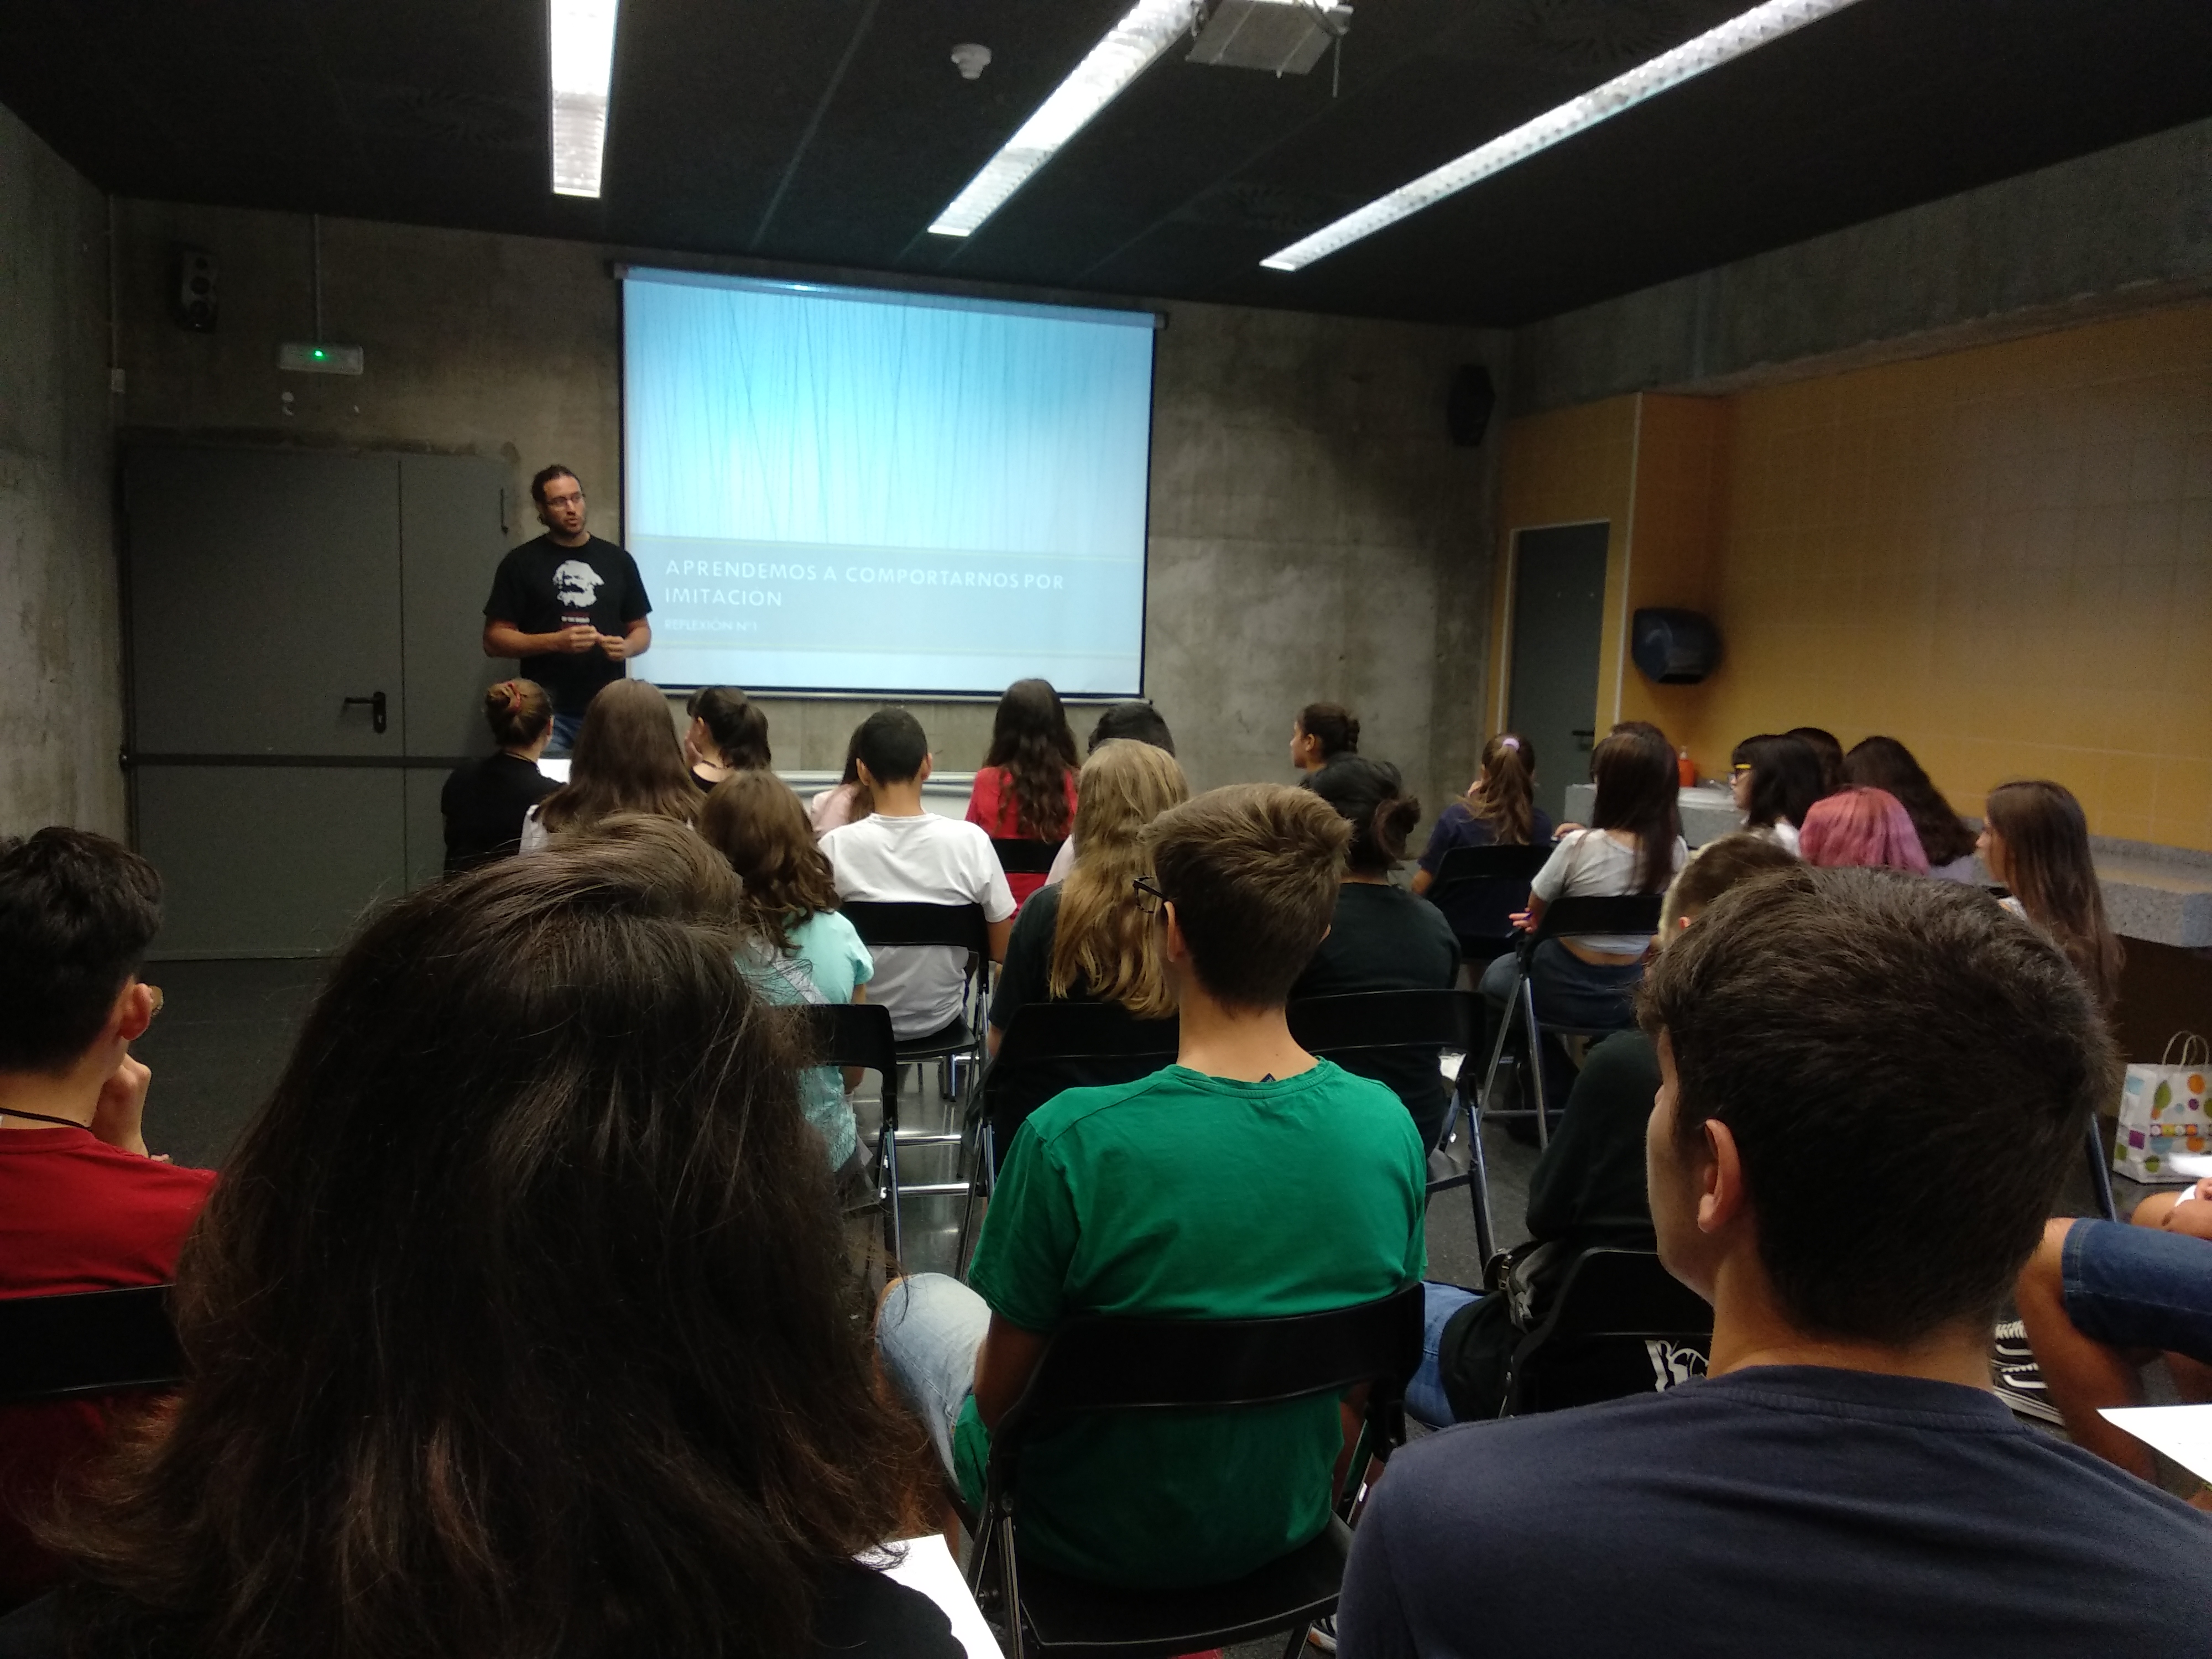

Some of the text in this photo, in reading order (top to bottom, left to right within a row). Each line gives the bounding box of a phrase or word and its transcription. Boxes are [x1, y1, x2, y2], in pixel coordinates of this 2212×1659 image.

[665, 559, 1063, 589] APRENDEMOS A COMPORTARNOS POR
[665, 587, 781, 607] IMITACIÓN
